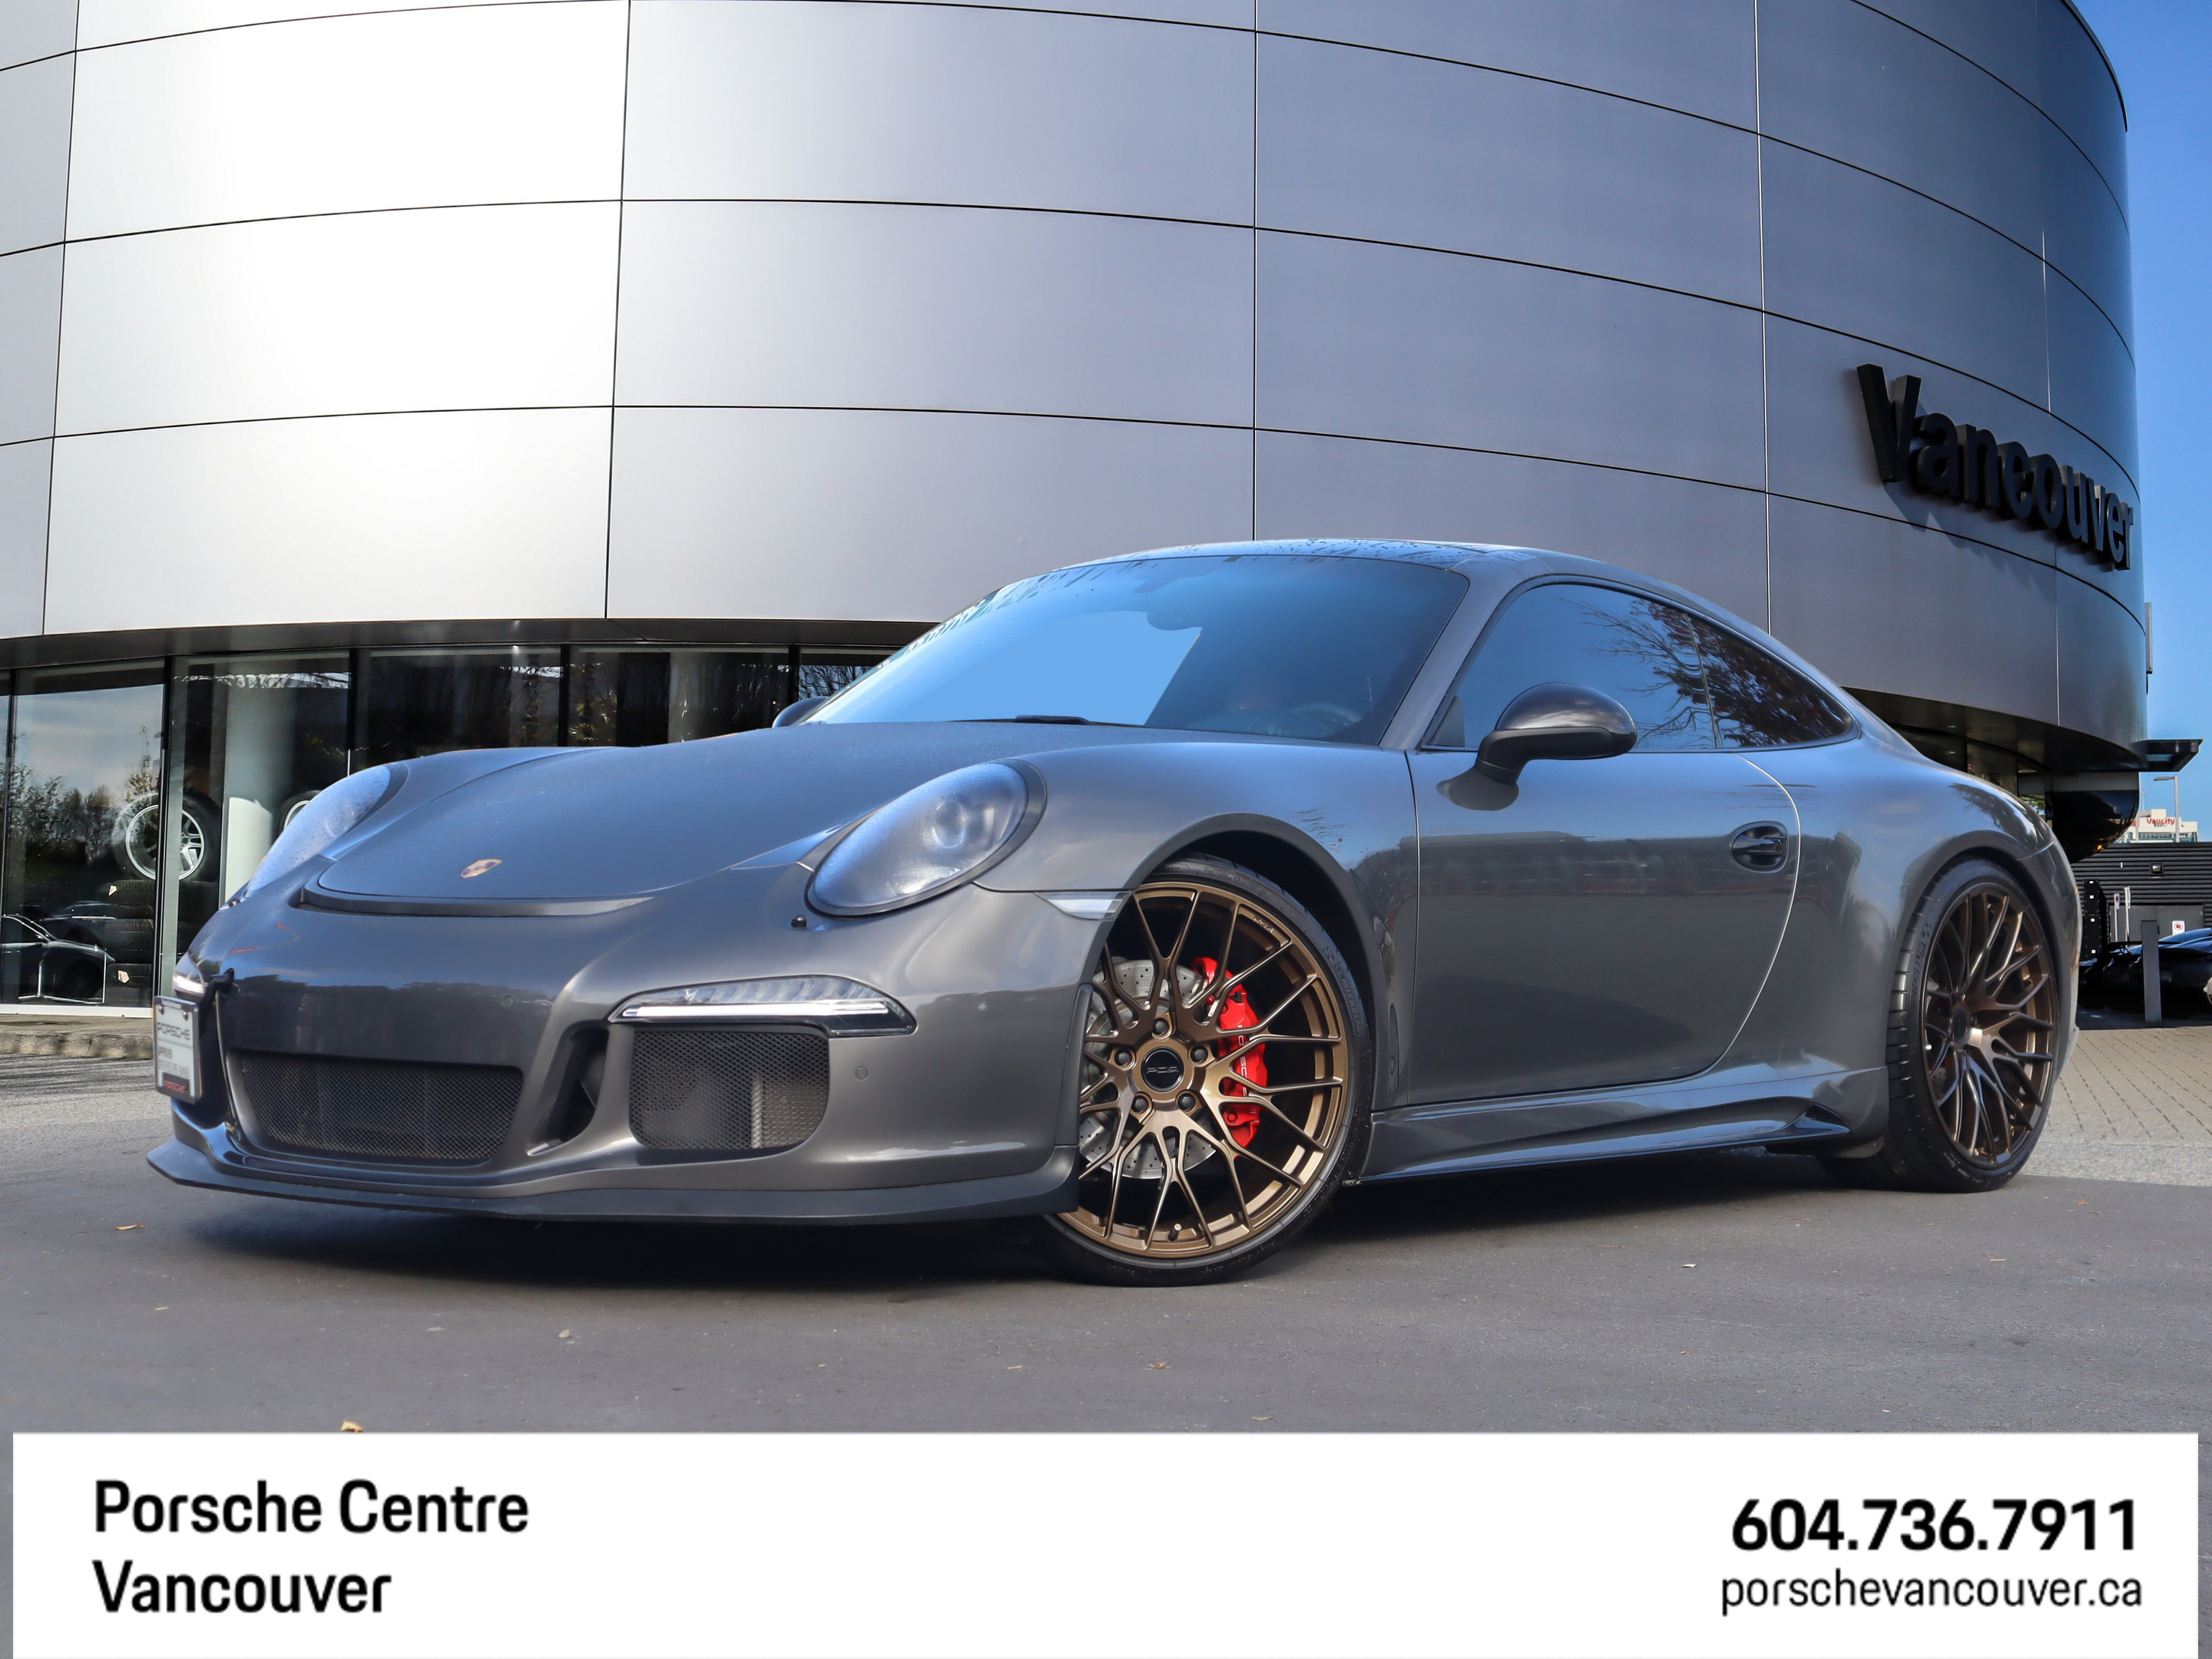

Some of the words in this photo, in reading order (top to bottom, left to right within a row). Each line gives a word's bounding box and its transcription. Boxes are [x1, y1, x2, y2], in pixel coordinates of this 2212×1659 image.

[1856, 363, 2134, 571] Vancouver
[2146, 817, 2175, 826] Vancity
[157, 1022, 190, 1040] PORSCHE
